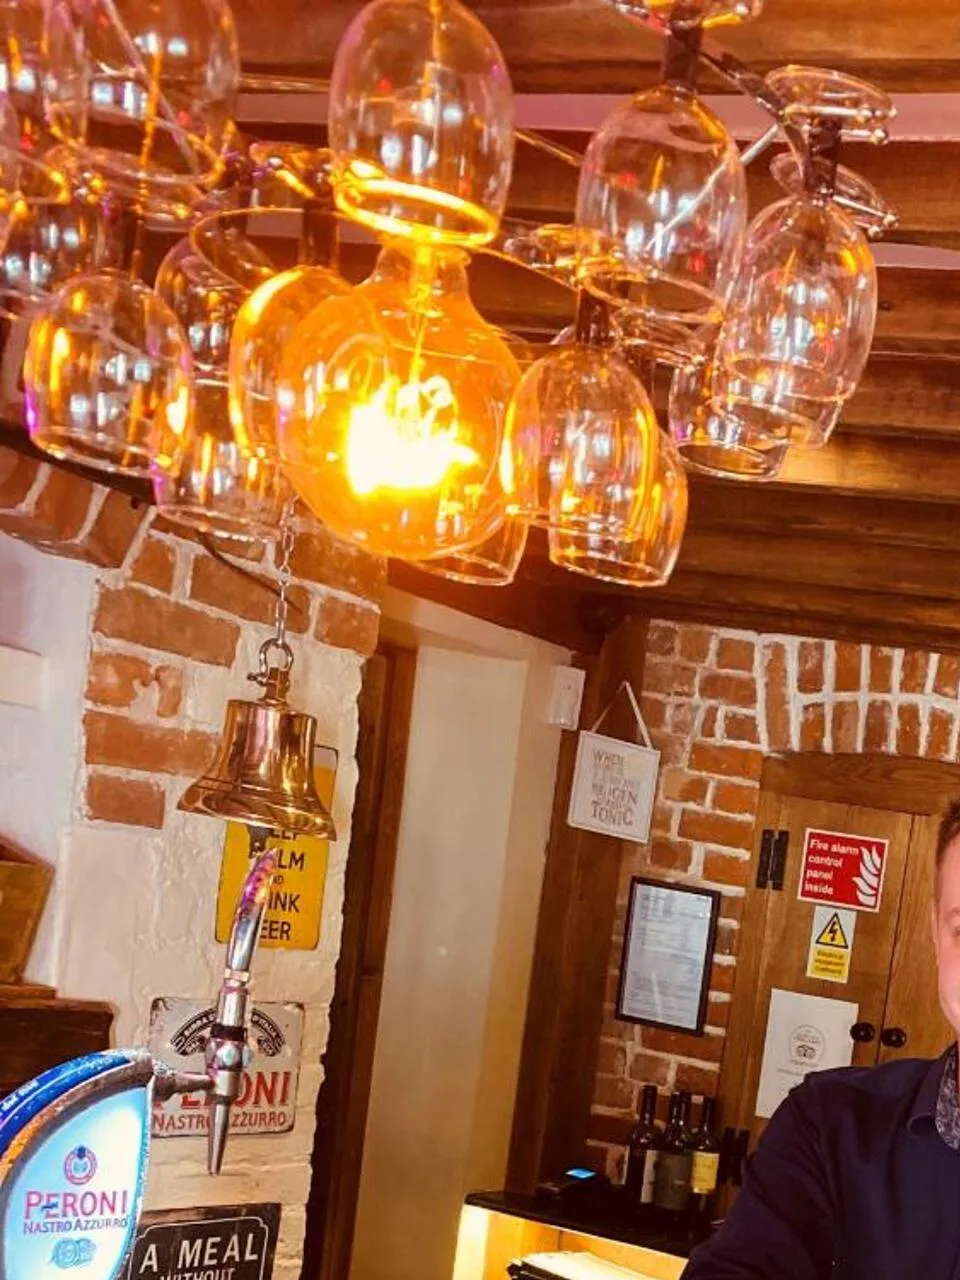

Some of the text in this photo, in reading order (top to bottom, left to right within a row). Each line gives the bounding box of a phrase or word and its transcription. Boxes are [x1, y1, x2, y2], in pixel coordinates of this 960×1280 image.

[809, 839, 860, 856] Fire alarm
[808, 855, 843, 868] control
[806, 870, 834, 881] panel
[804, 882, 834, 895] inside
[259, 919, 291, 941] EER
[151, 1110, 288, 1131] NASTR ZZURRO
[24, 1189, 129, 1220] PERONI
[23, 1215, 129, 1236] NASTRO AZZURRO
[139, 1233, 259, 1275] A MEAL
